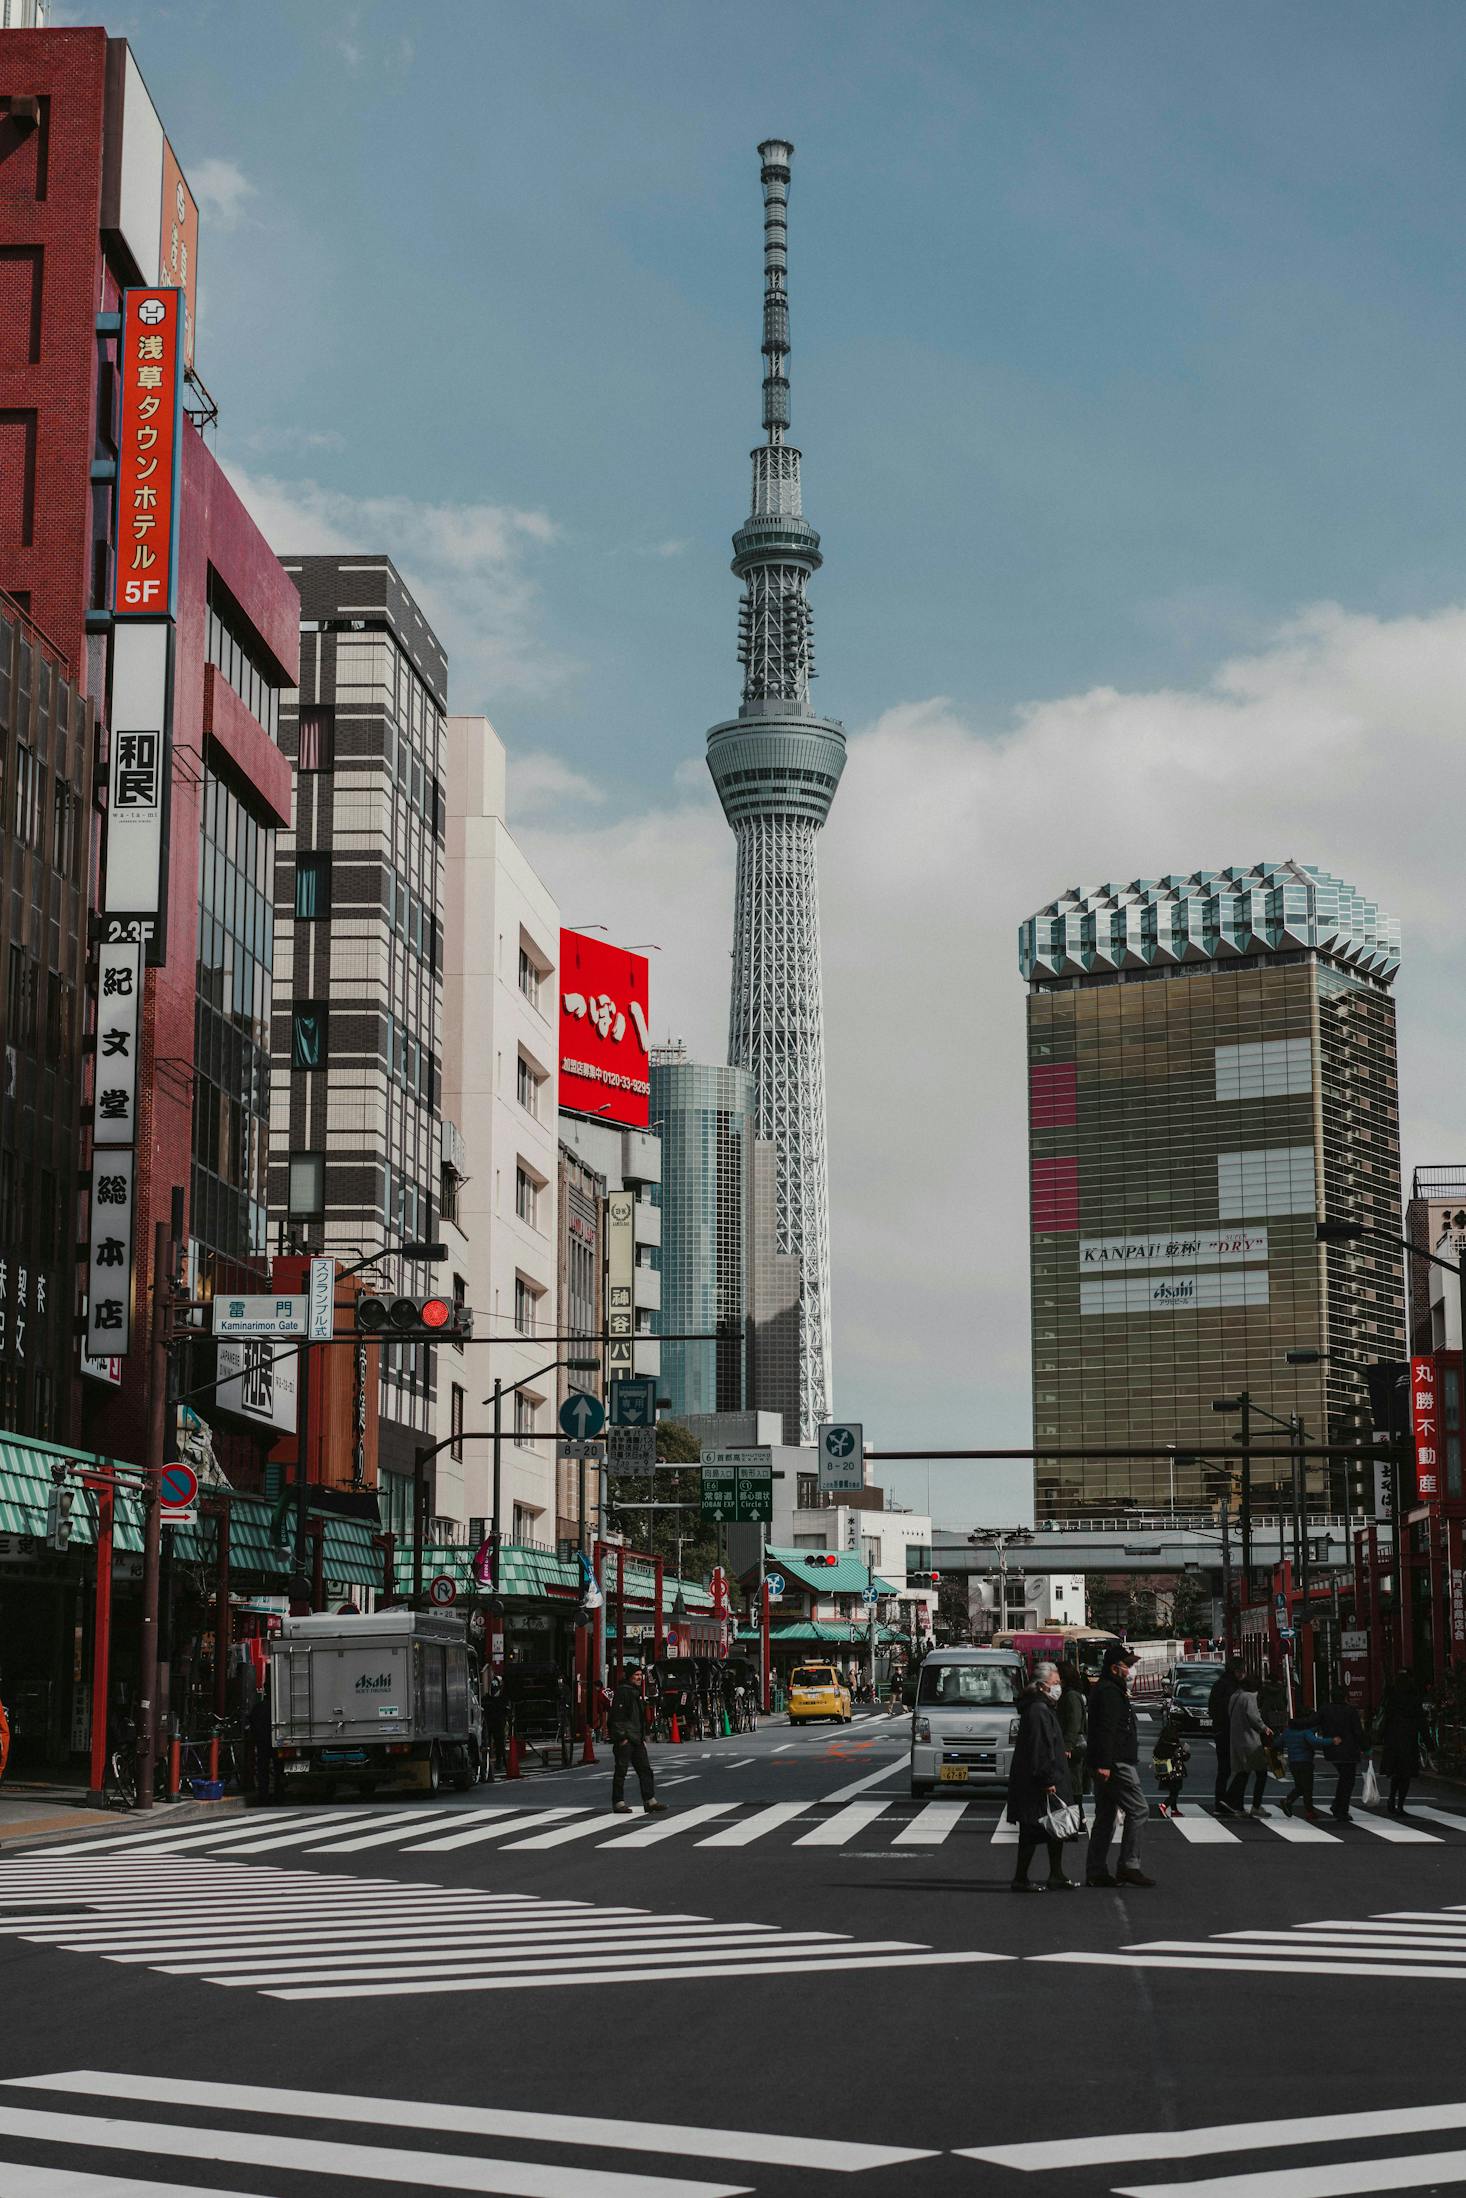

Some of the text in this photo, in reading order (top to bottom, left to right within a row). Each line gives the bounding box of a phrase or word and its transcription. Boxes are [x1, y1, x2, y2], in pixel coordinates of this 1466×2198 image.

[130, 335, 164, 571] 浅草タウンホテル
[124, 579, 161, 605] 5F
[118, 735, 155, 804] 和民
[99, 968, 133, 1119] 紀文堂
[603, 1070, 651, 1095] 0120-33-9295
[94, 1175, 128, 1330] 総本店
[314, 1262, 329, 1337] スクランブル式
[1153, 1280, 1193, 1299] Asahi
[229, 1301, 293, 1318] 雷門
[221, 1321, 299, 1331] Kaminarimon Gate
[1414, 1364, 1439, 1493] 丸勝不動産
[706, 1453, 712, 1462] 6
[355, 1673, 392, 1689] Asahi
